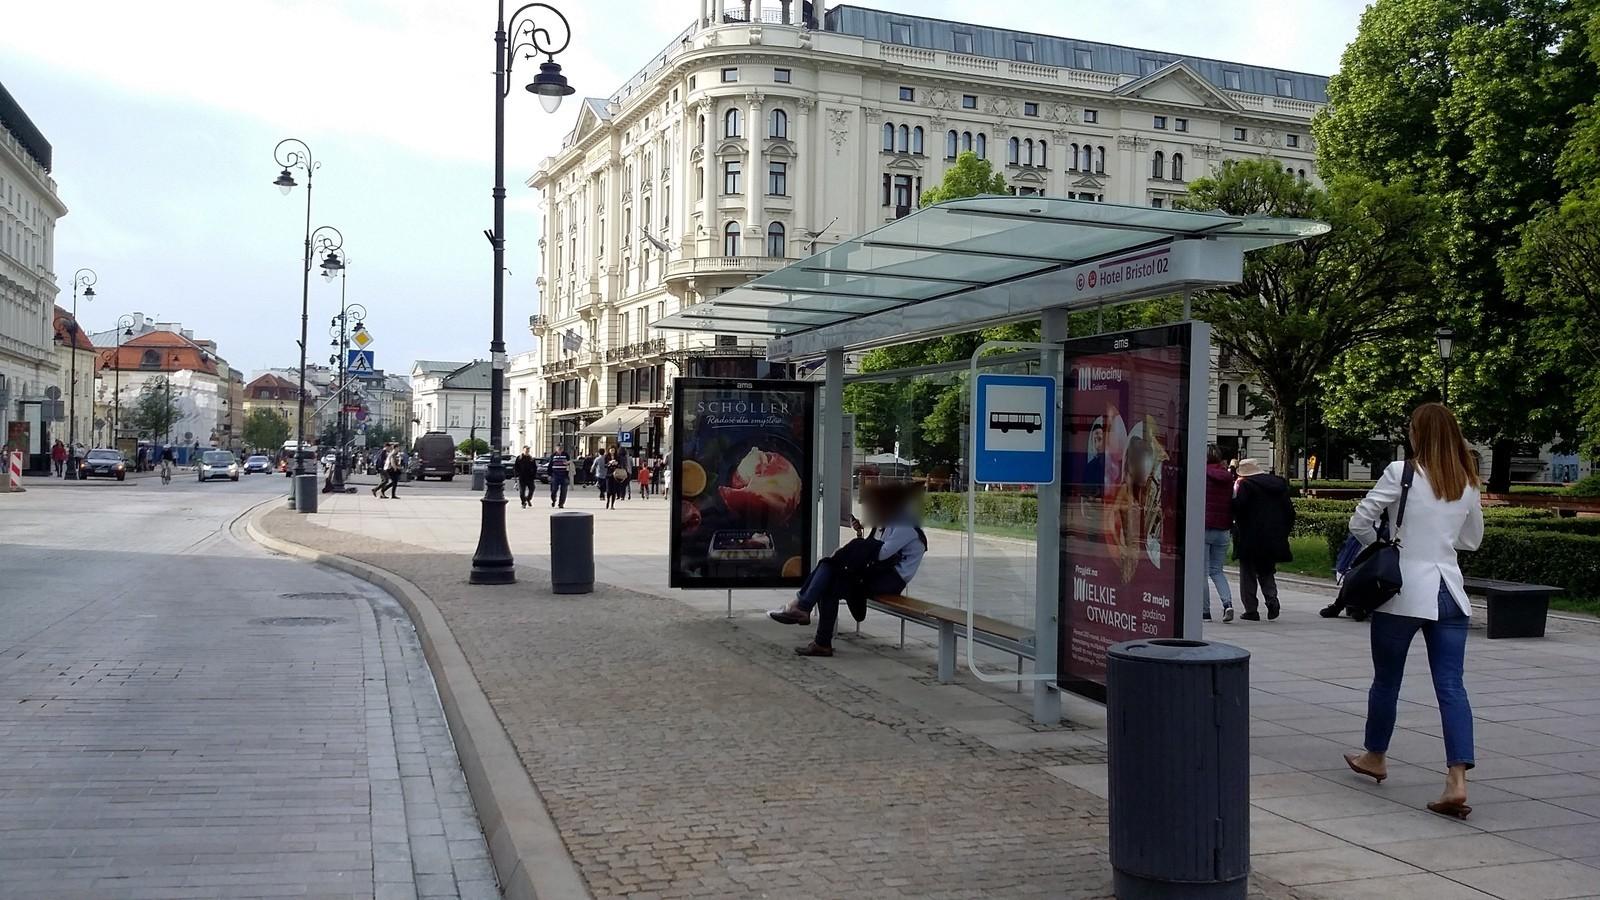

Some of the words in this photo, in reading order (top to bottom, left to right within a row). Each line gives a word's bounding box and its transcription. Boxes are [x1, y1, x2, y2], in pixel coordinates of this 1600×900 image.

[1100, 266, 1123, 286] Hotel
[1126, 259, 1155, 280] Bristol
[1157, 257, 1169, 274] 02
[1113, 338, 1129, 349] ams
[697, 401, 790, 413] SCHÖLLER
[623, 432, 631, 442] P
[1073, 576, 1117, 606] WIELKIE
[1142, 591, 1152, 603] 23
[1152, 595, 1170, 608] maja
[1086, 605, 1137, 632] OTWARCIE
[1141, 609, 1166, 622] godzina
[1141, 622, 1158, 636] 12:00
